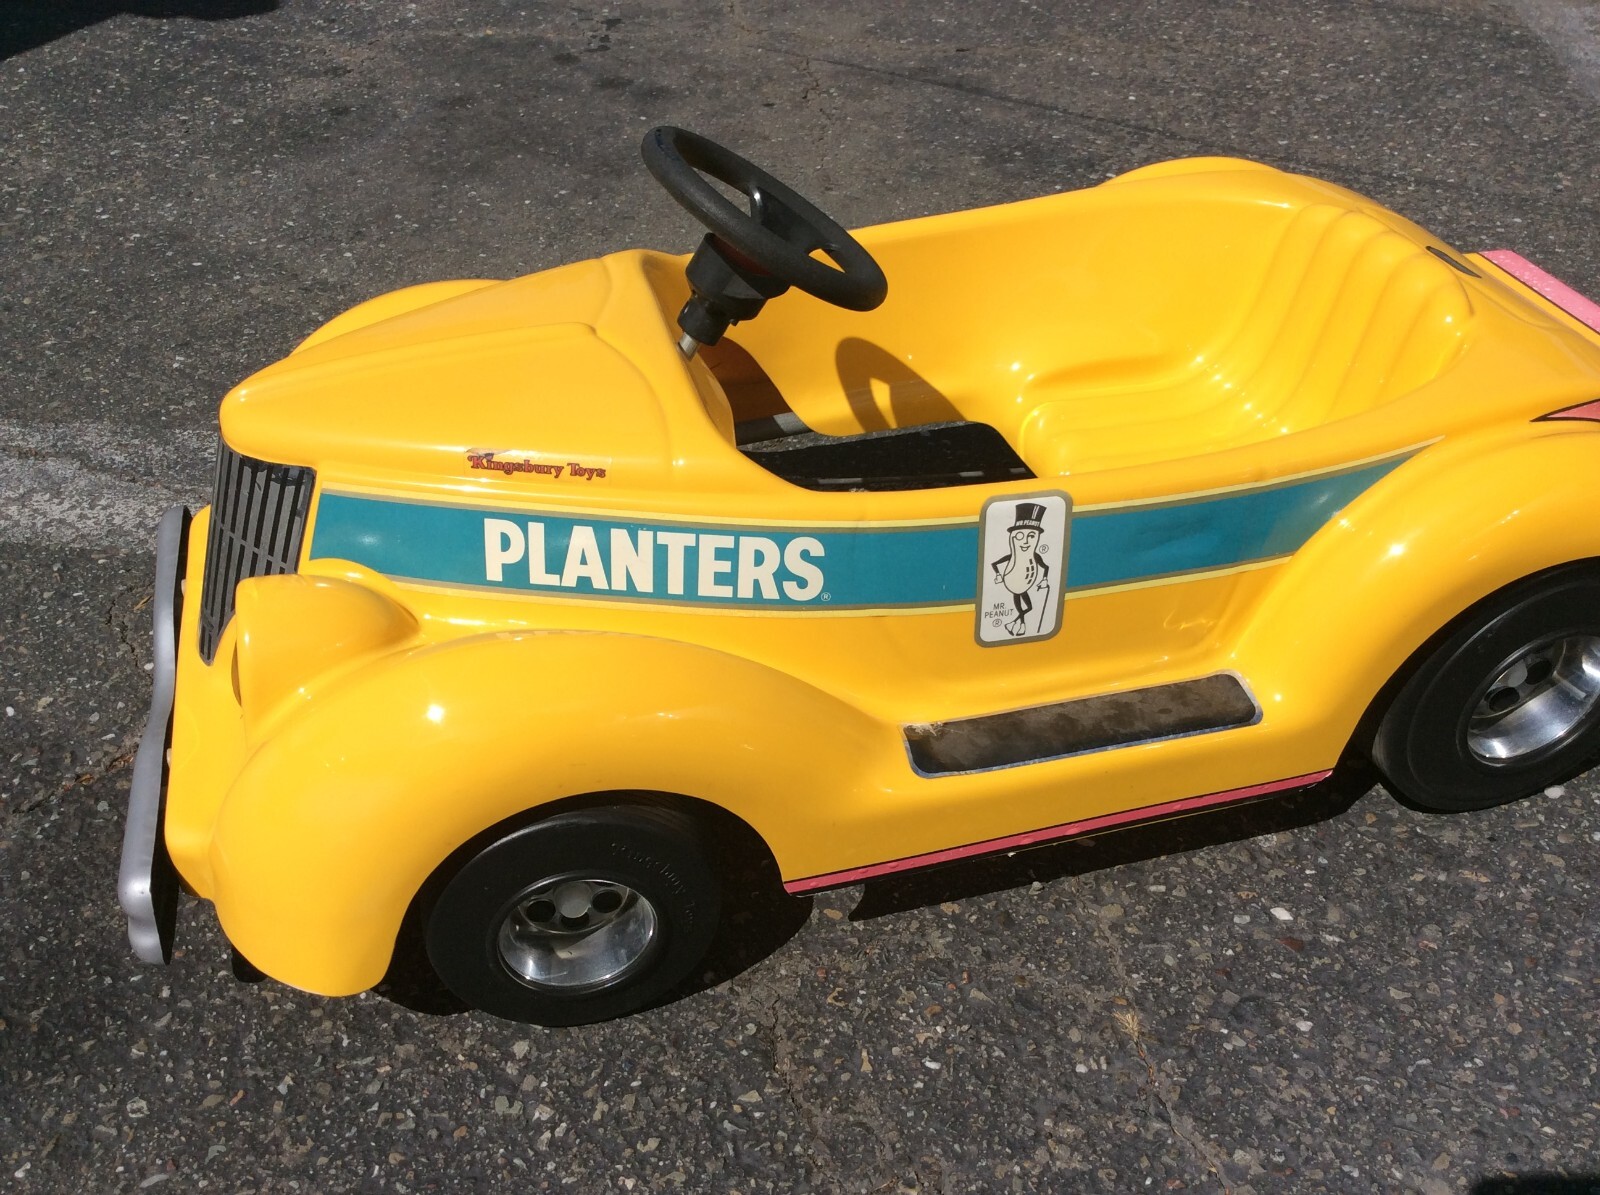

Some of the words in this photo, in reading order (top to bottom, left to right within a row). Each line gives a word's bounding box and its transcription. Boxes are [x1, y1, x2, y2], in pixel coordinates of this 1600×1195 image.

[467, 453, 564, 478] Kingsbury
[567, 462, 606, 481] Toys
[483, 518, 825, 601] PLANTERS
[984, 608, 1014, 619] PEANUT
